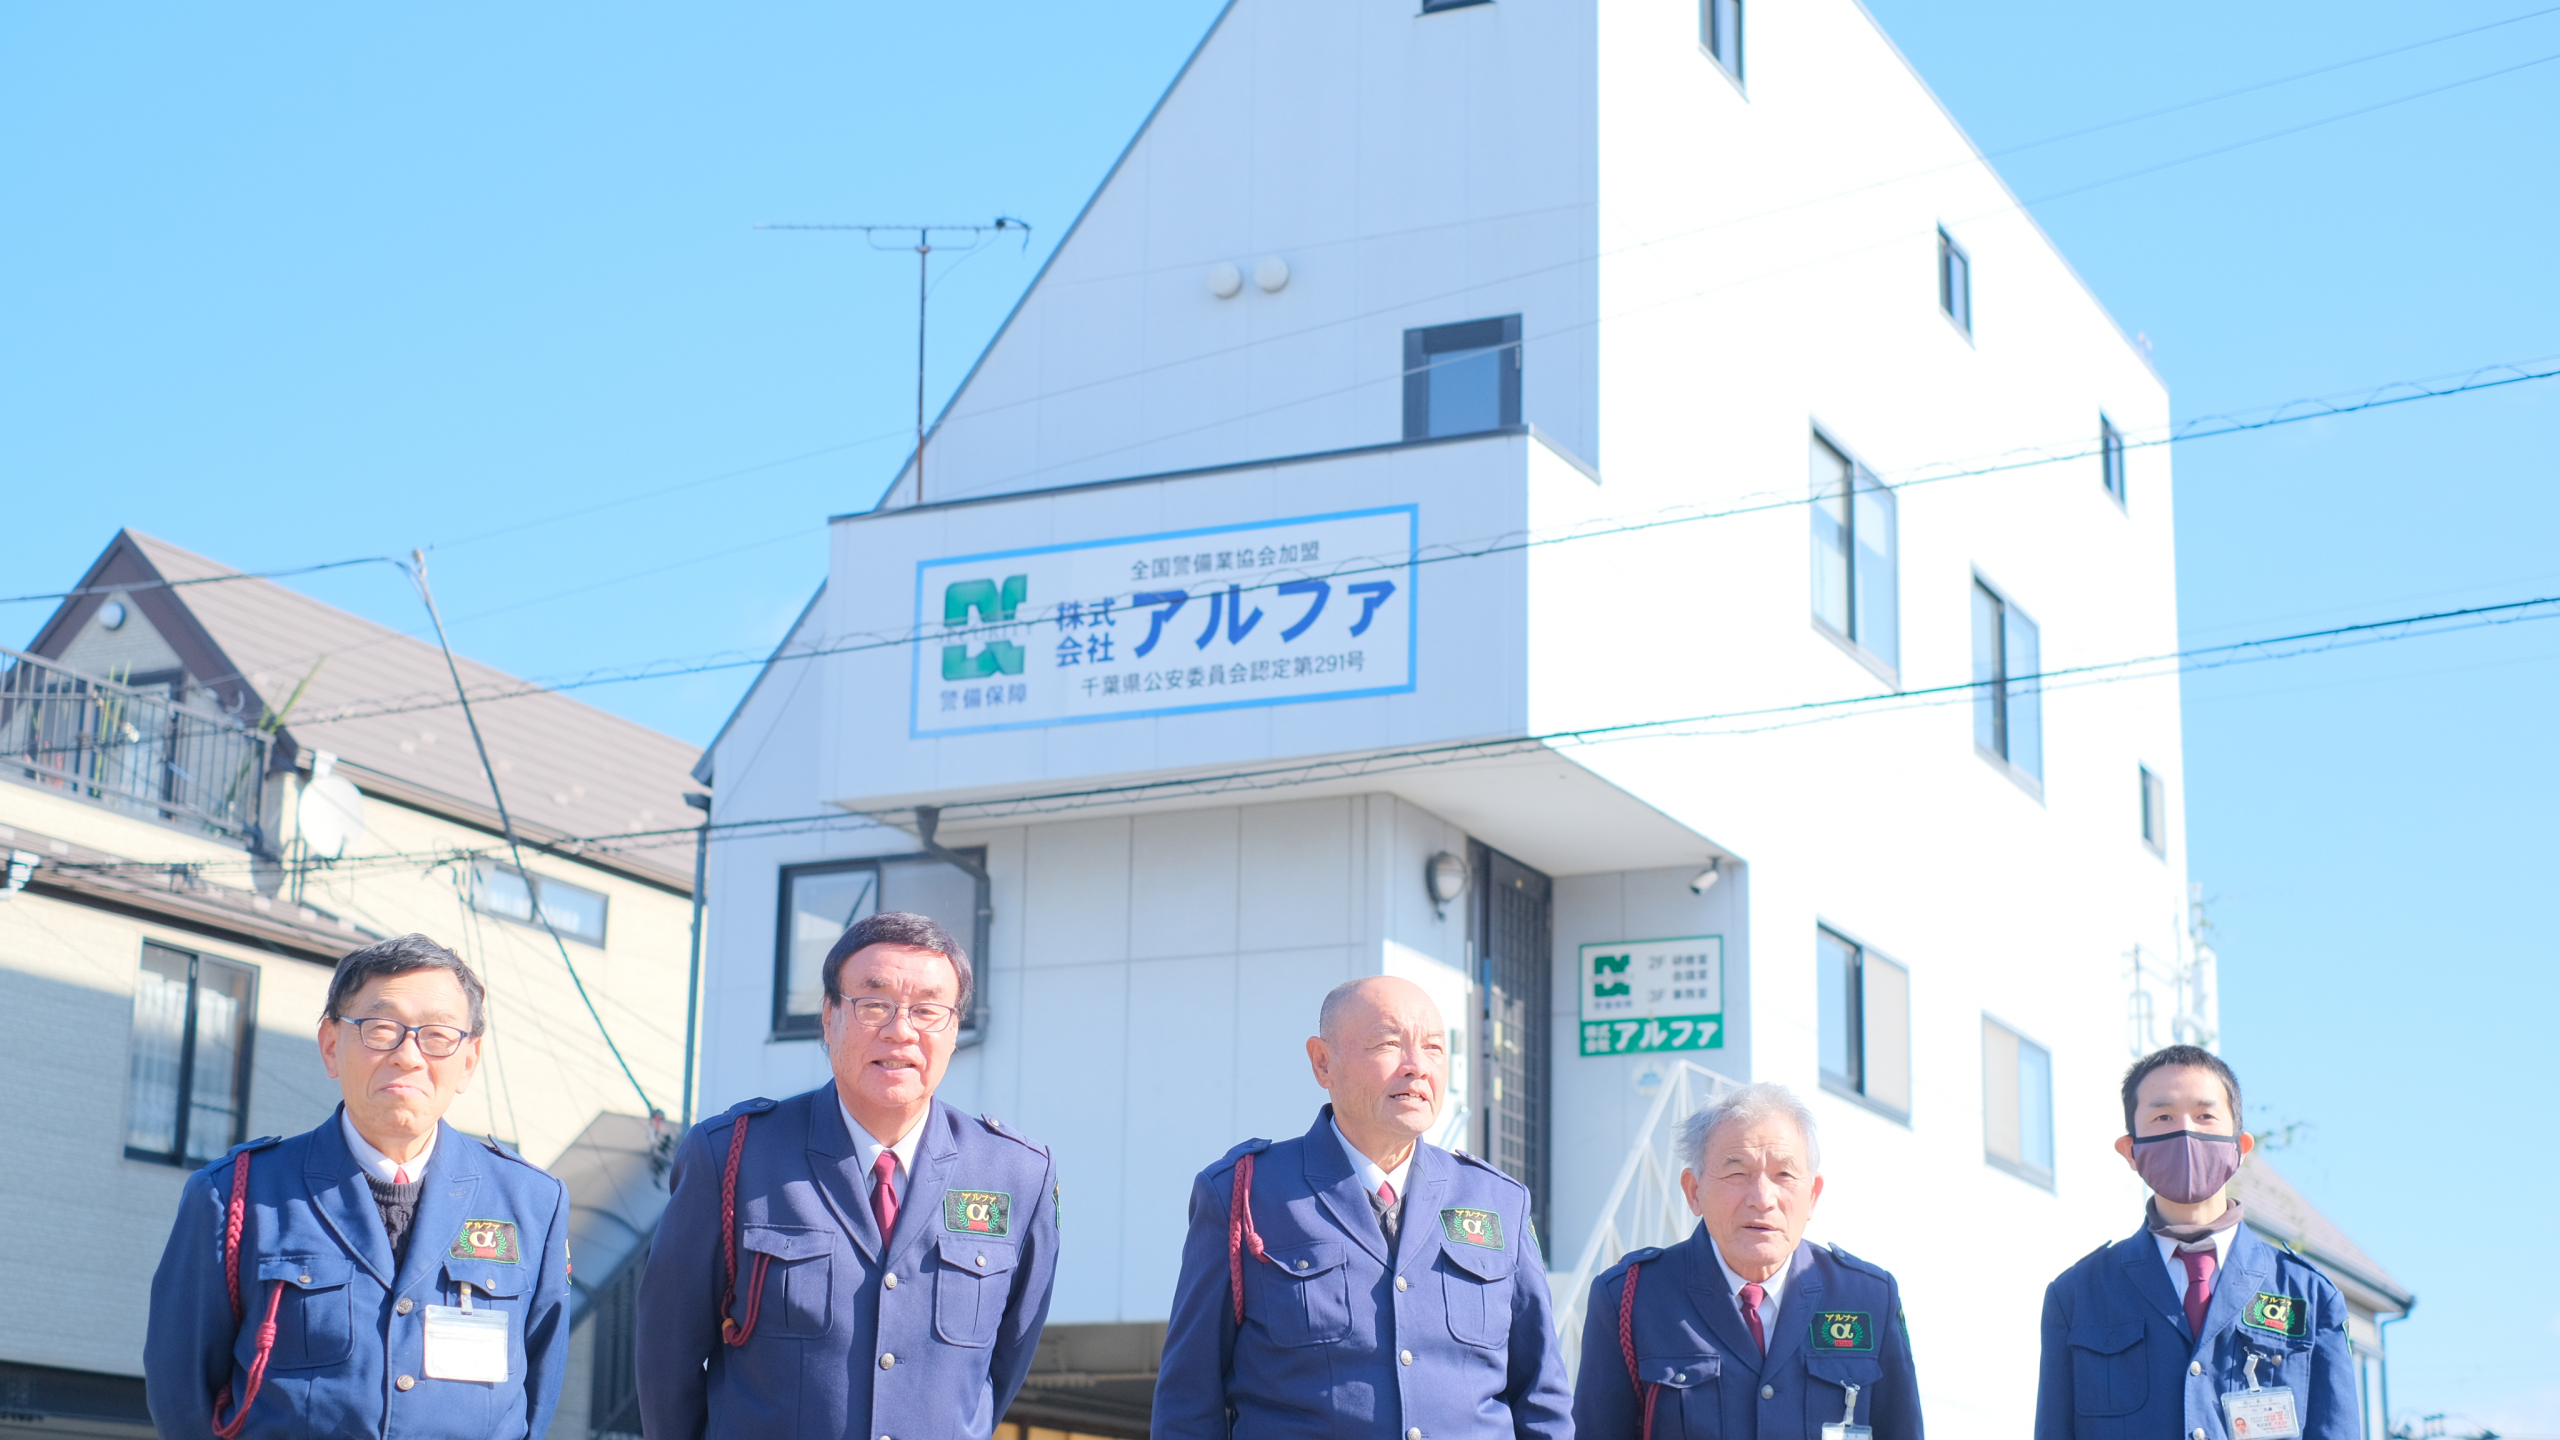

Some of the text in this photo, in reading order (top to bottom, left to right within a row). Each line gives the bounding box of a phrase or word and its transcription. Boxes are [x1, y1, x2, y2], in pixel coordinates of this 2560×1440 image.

[1131, 540, 1319, 581] 全国警備業協会加盟
[1056, 597, 1116, 632] 株式
[1133, 580, 1397, 658] アルファ
[1056, 632, 1115, 667] 会社
[1081, 650, 1365, 697] 千葉県公安委員会認定第291号
[1613, 1020, 1719, 1051] アルファ
